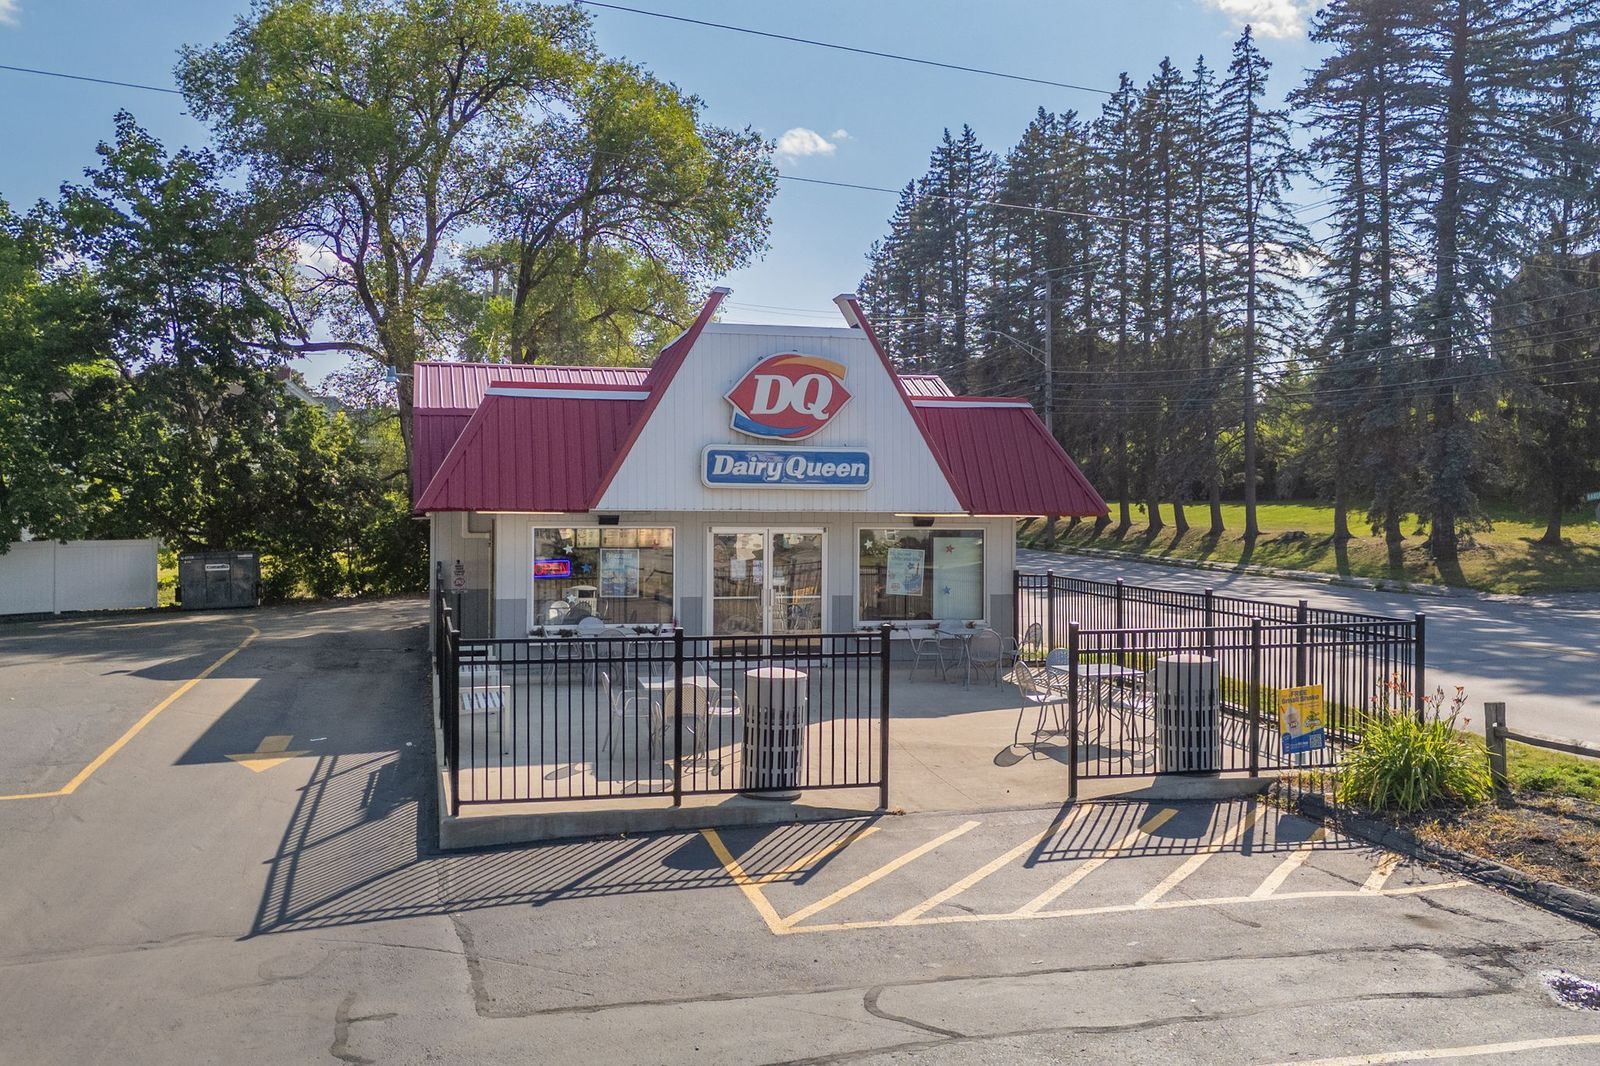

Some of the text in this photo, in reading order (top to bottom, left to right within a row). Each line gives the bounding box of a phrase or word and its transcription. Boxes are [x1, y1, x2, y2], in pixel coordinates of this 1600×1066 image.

[750, 373, 833, 420] DQ
[712, 454, 866, 481] Dairy Queen
